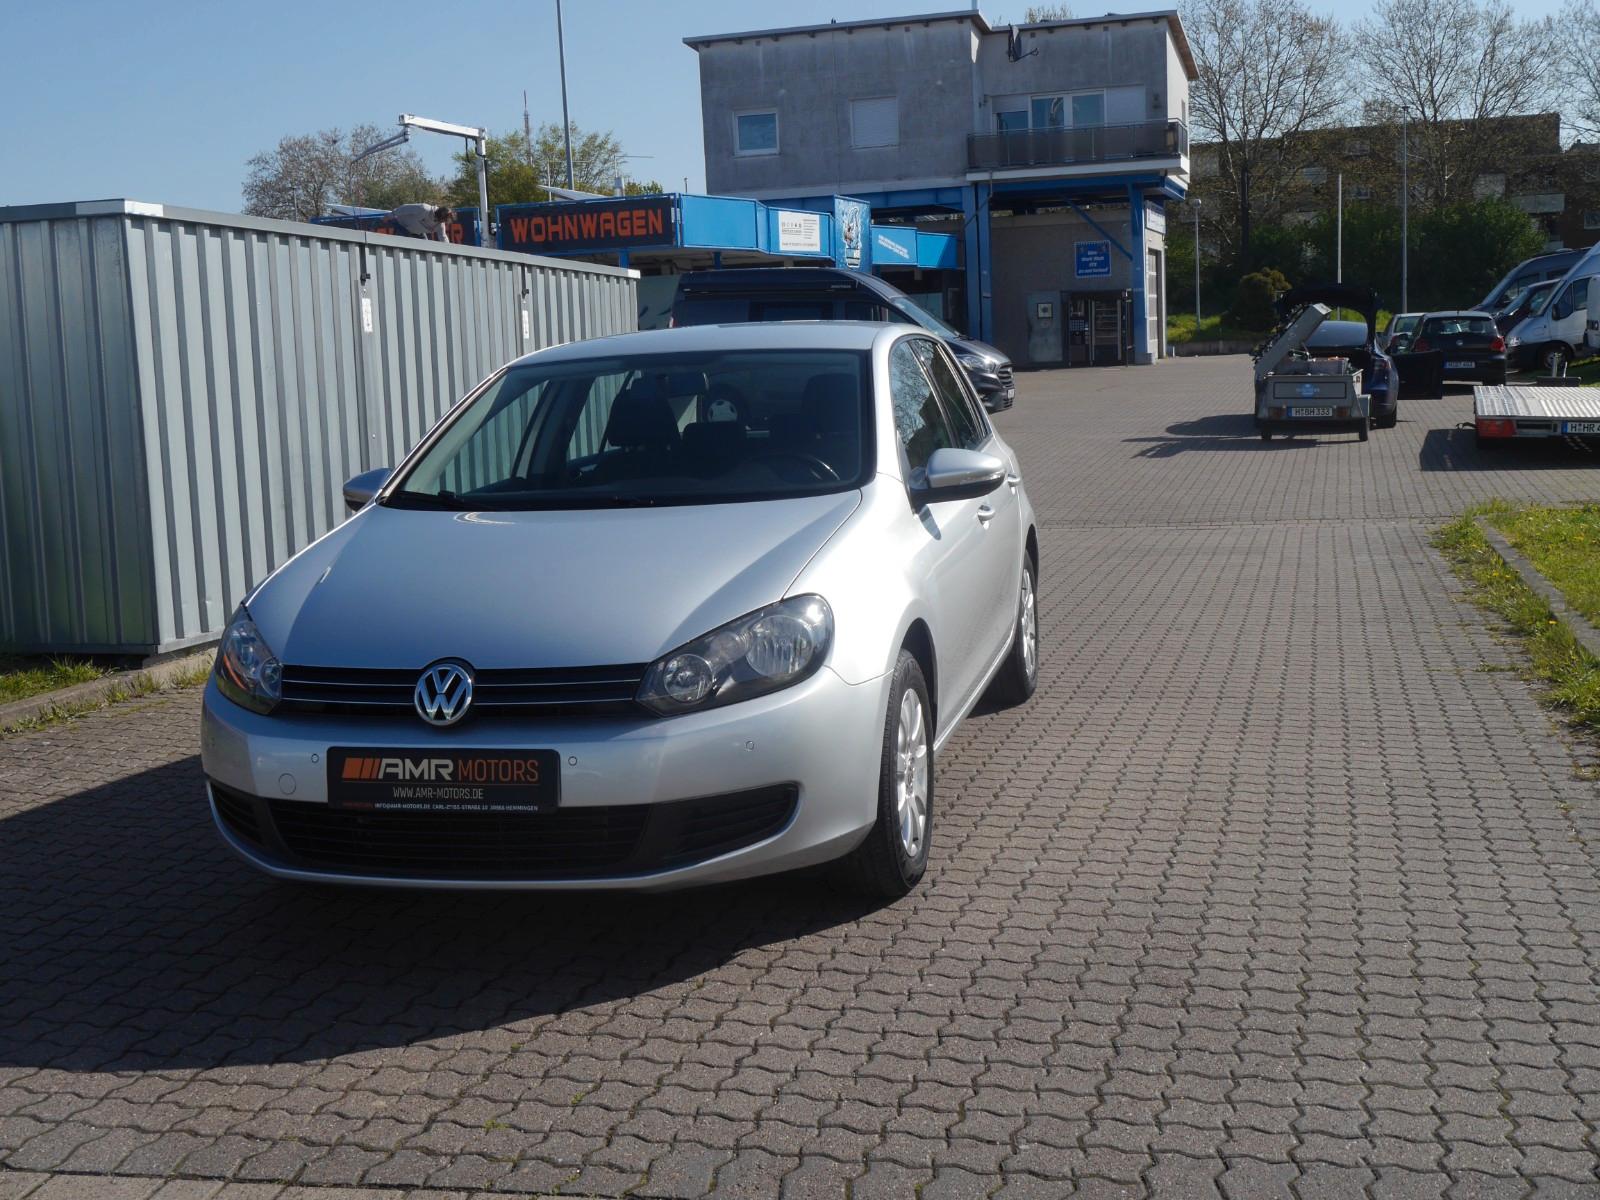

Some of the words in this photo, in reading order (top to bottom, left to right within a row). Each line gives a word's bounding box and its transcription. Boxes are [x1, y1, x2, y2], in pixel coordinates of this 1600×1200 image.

[509, 208, 664, 244] WOHNWAGEN
[415, 664, 472, 726] VW
[378, 758, 455, 781] AMR
[458, 759, 539, 782] MOTORS
[392, 786, 484, 799] WWW.AMR-MOTORS.DE
